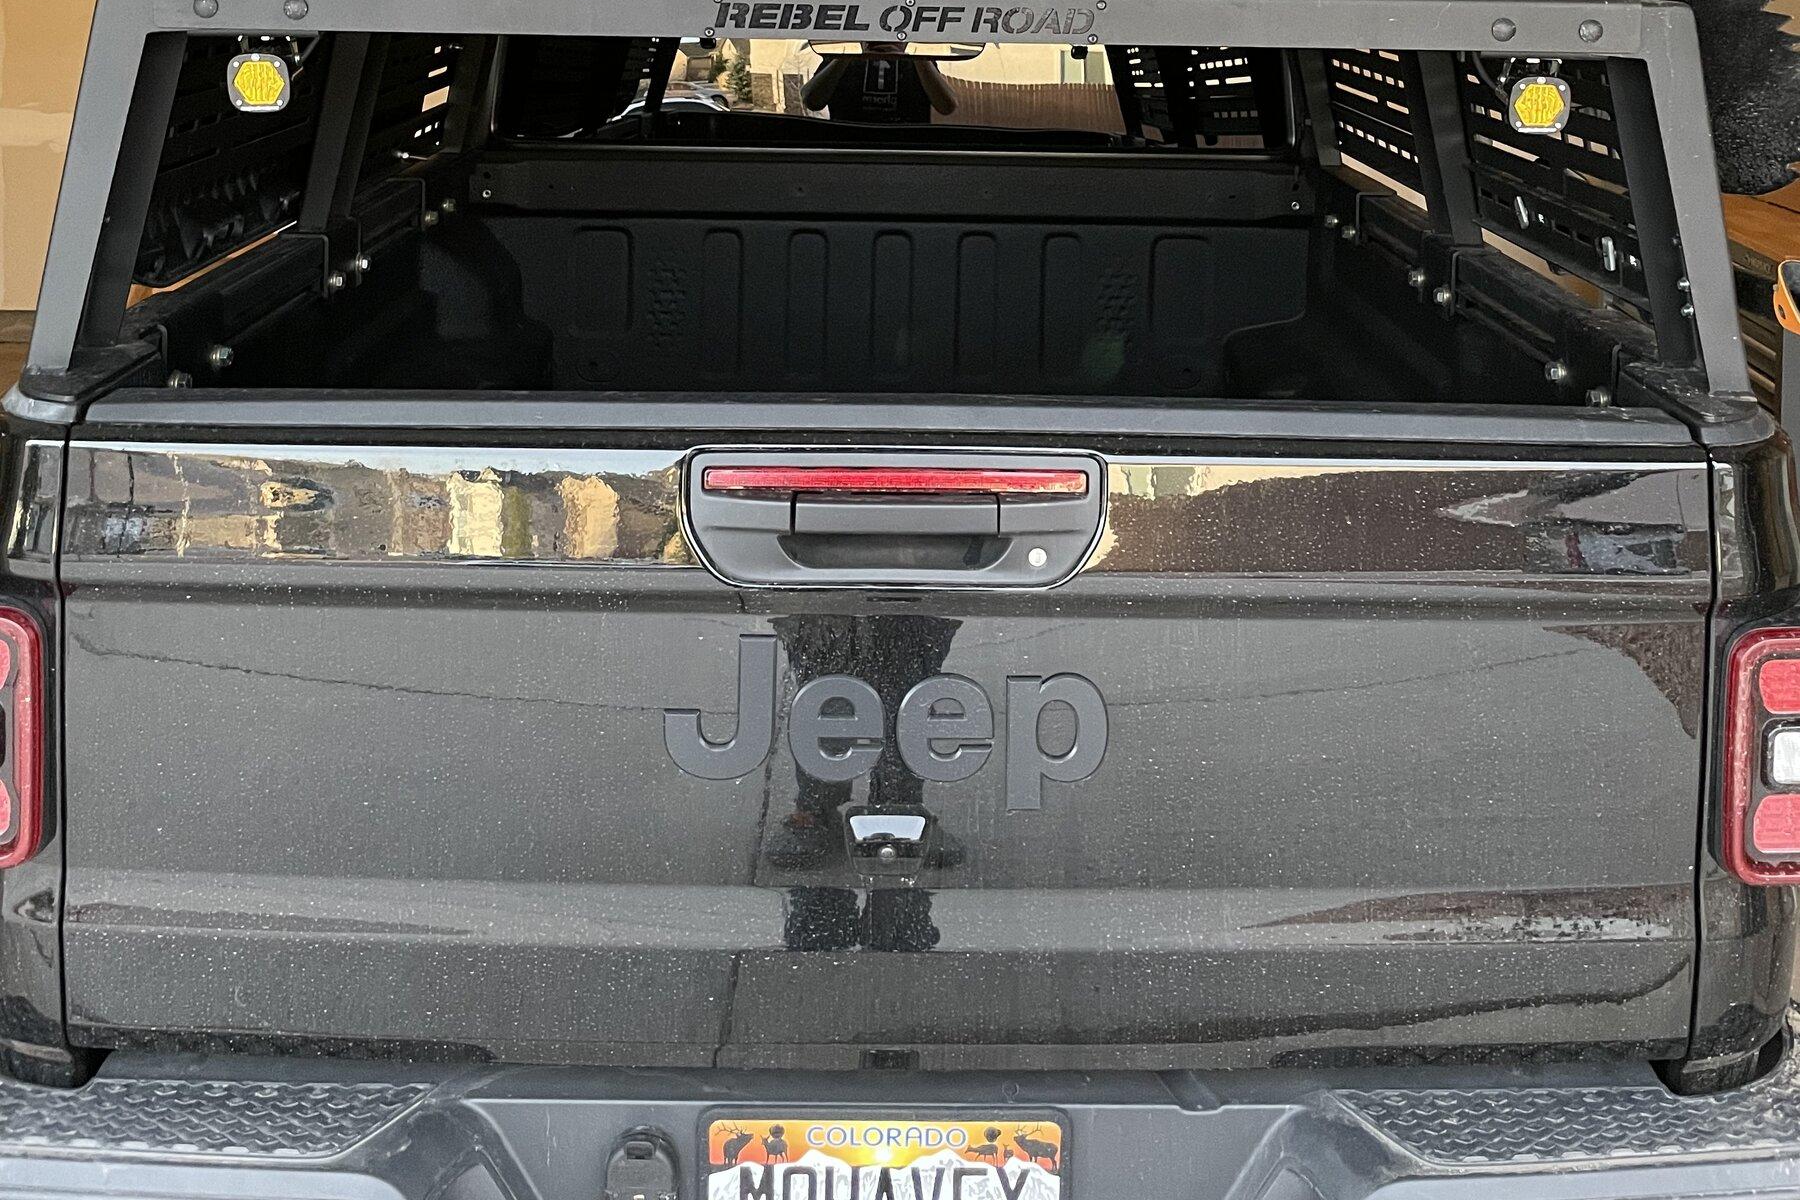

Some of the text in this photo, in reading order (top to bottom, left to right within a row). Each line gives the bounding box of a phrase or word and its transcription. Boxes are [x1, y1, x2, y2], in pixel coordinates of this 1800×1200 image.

[714, 2, 1096, 35] REBEL OFF ROAD
[663, 633, 1109, 812] Jeep
[805, 1125, 969, 1148] COLORADO
